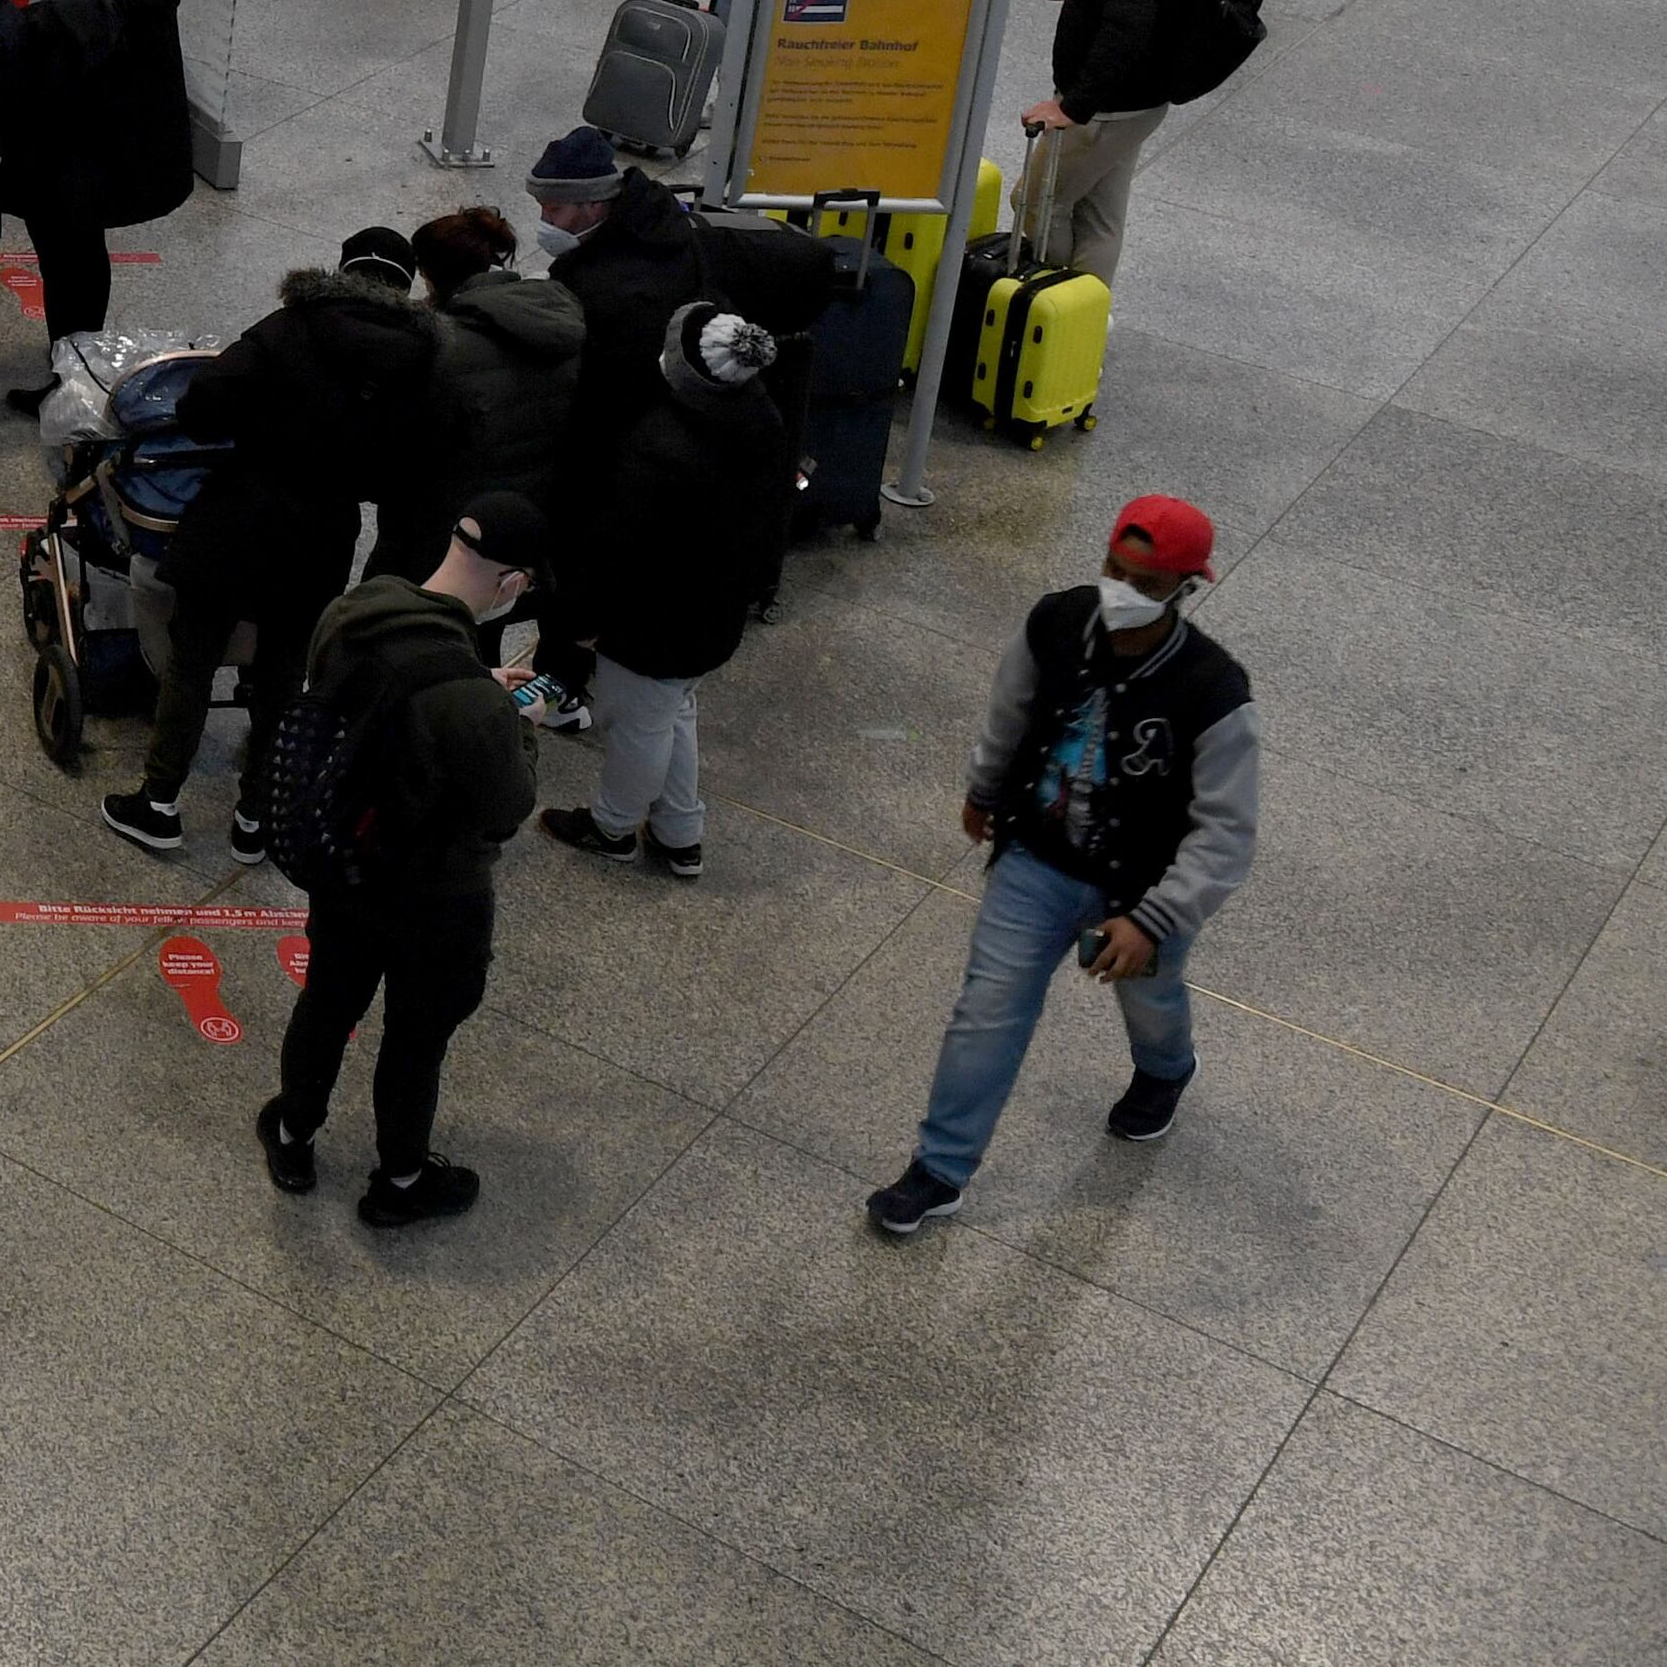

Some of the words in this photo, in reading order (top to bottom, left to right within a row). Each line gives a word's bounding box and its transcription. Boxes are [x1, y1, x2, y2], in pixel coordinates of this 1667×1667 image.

[778, 38, 855, 50] Rauchfreier
[860, 40, 919, 51] Bahnhof
[38, 905, 71, 913] Bitte
[74, 905, 136, 914] Rücksicht
